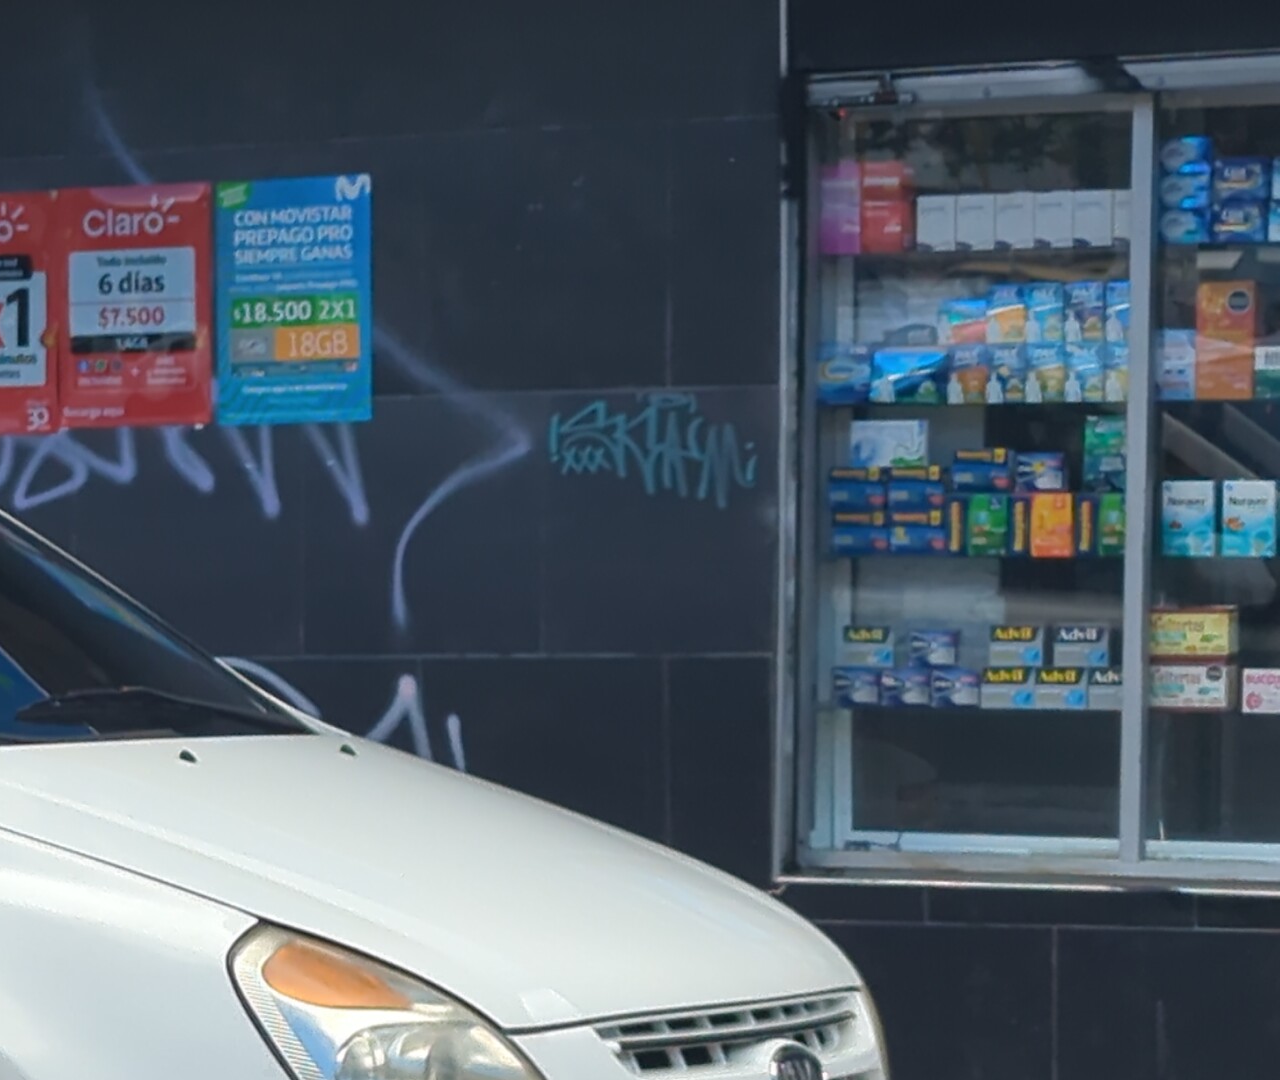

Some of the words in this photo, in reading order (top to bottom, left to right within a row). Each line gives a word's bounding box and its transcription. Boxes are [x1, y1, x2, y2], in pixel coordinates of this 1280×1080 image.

[82, 204, 168, 238] Claro
[233, 210, 268, 226] CON
[270, 204, 353, 225] MOVISTAR
[233, 227, 314, 247] PREPAGO
[317, 224, 354, 242] PRO
[234, 247, 297, 265] SIEMPRE
[301, 243, 353, 262] GANAS
[98, 273, 113, 295] 6
[118, 270, 165, 294] días
[98, 305, 165, 329] $7.500
[233, 299, 313, 324] $18.500
[288, 327, 349, 358] 18GB
[993, 626, 1034, 640] Advil
[1058, 627, 1098, 641] Advil
[984, 668, 1025, 682] Advil
[1040, 669, 1078, 683] Advil
[1093, 670, 1122, 684] Adv
